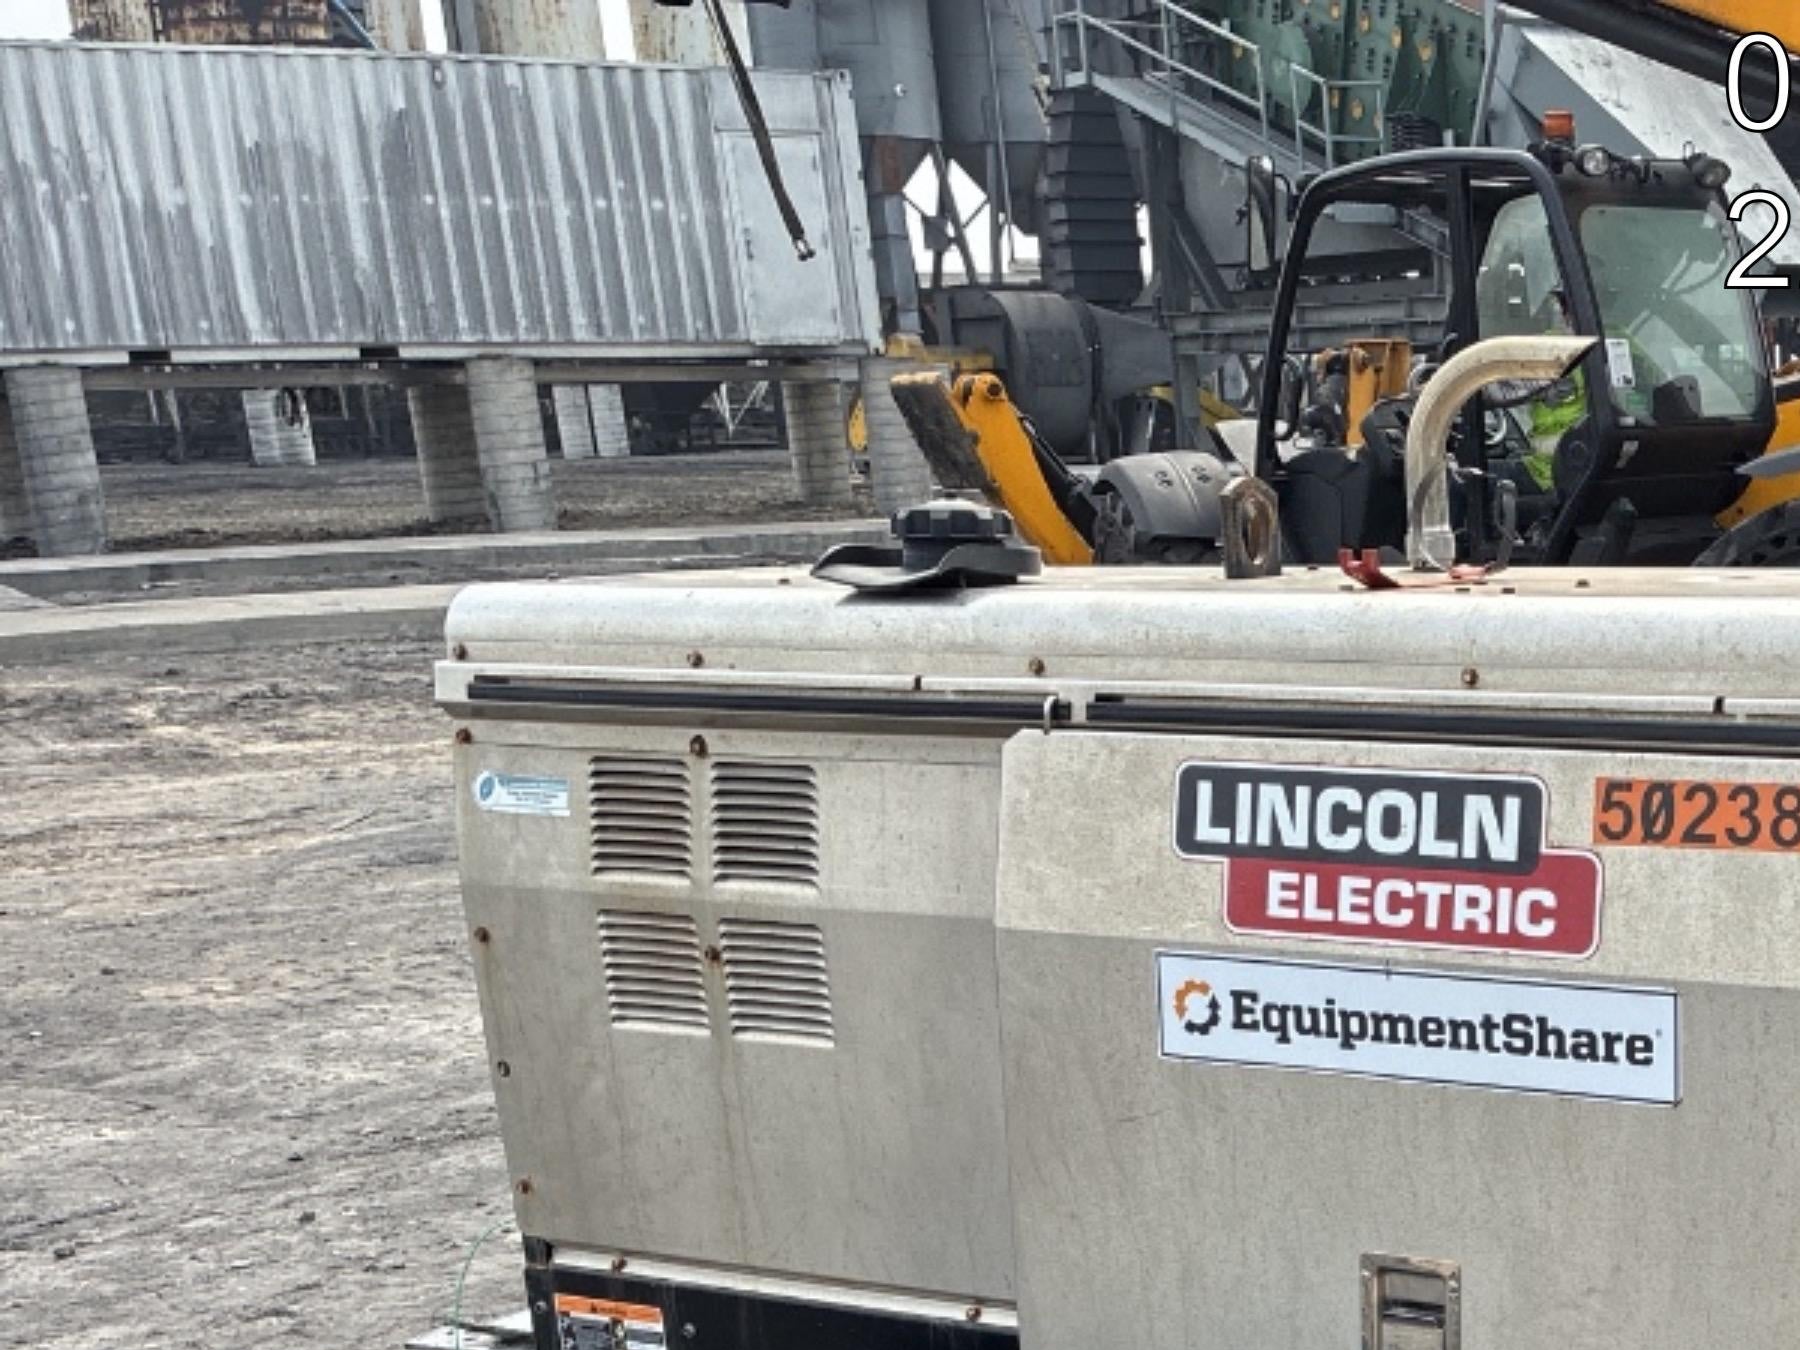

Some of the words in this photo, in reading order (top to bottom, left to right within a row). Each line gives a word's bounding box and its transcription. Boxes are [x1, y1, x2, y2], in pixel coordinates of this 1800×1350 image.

[1195, 779, 1521, 863] LINCOLN
[1266, 869, 1558, 938] ELECTRIC
[1230, 989, 1655, 1066] EquipmentShare
